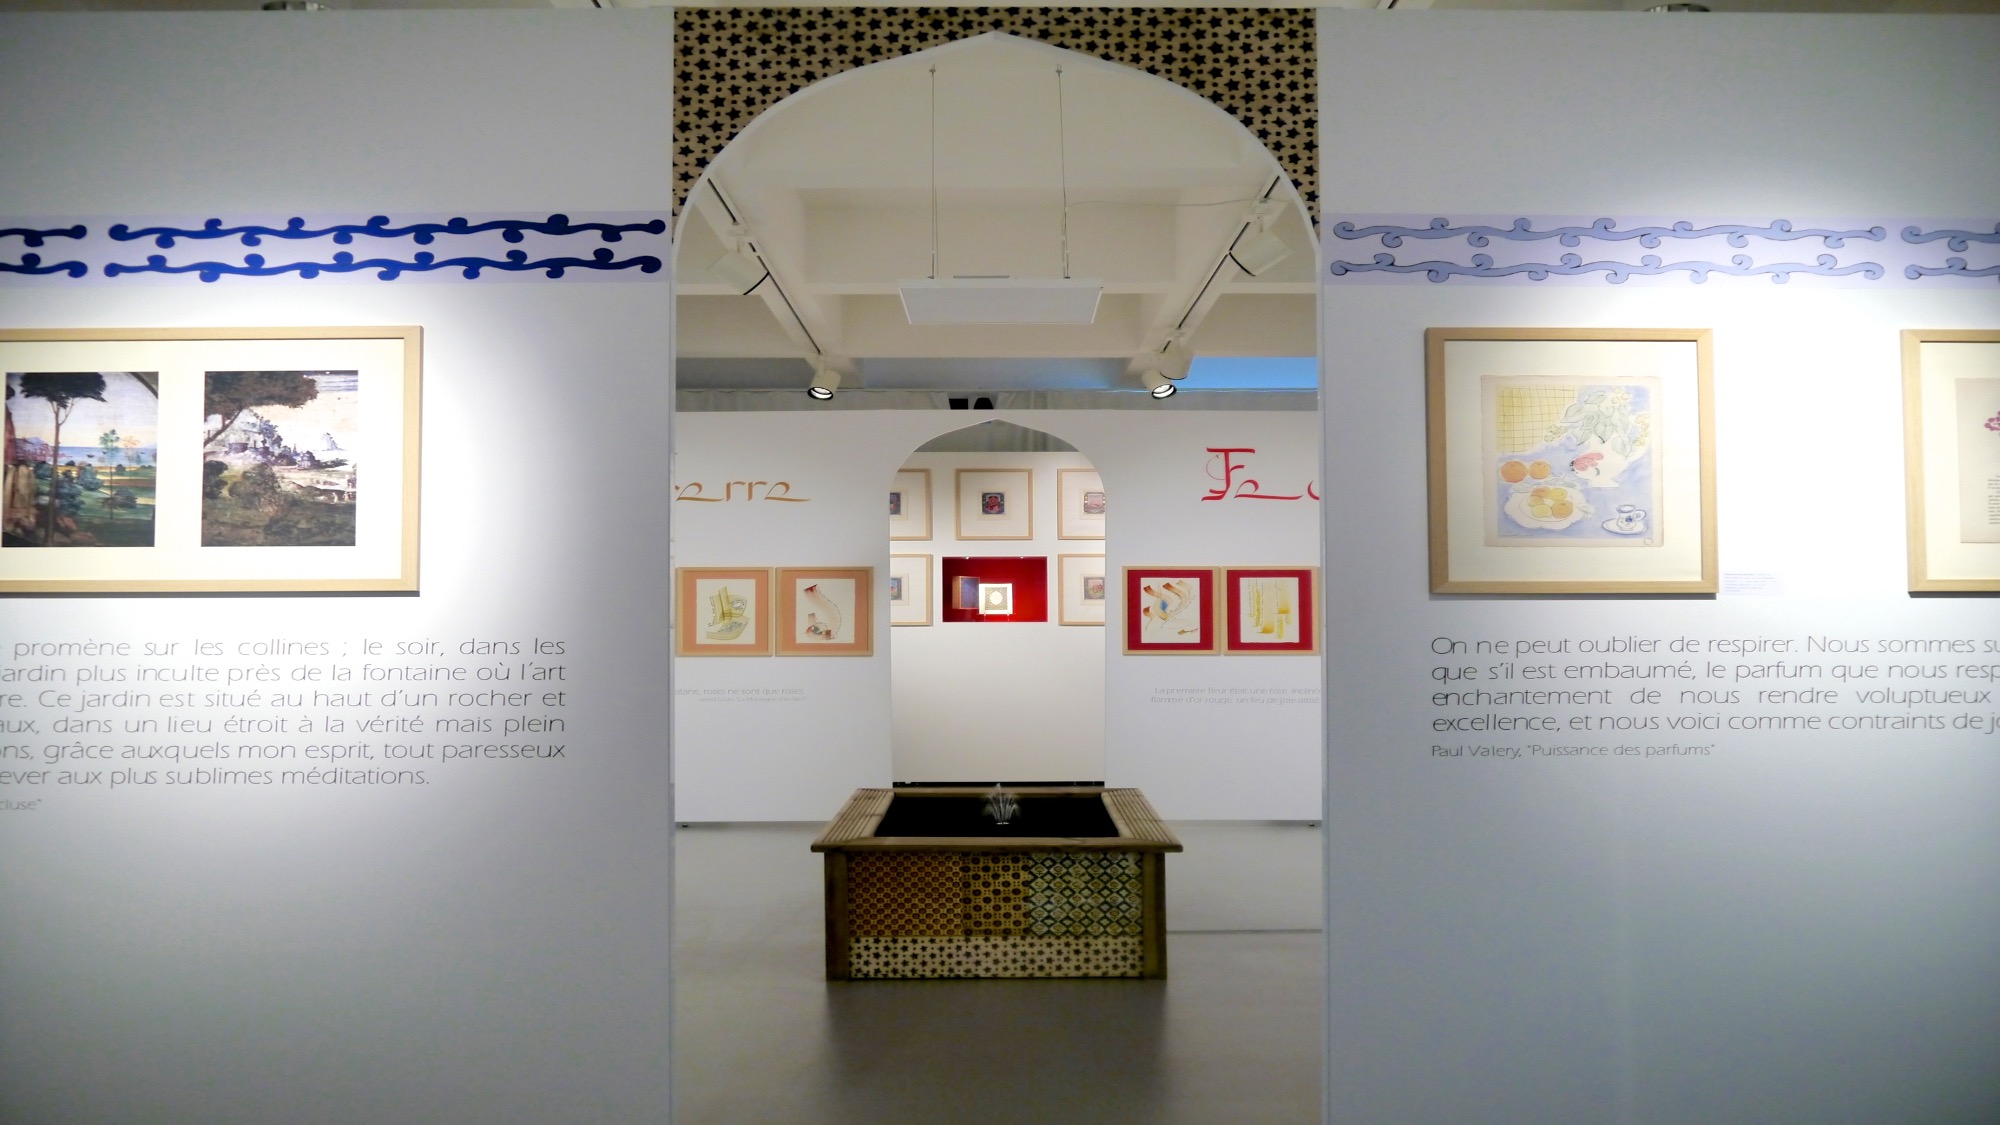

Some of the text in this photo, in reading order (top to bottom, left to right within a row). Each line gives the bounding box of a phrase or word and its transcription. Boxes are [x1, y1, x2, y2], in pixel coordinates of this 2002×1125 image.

[675, 480, 811, 502] erre
[14, 639, 131, 661] promène
[144, 642, 179, 656] sur
[195, 639, 223, 656] les
[238, 639, 329, 655] collines
[364, 638, 382, 655] le
[396, 638, 444, 657] soir,
[460, 638, 520, 655] dans
[535, 638, 565, 654] les
[1431, 637, 1467, 654] On
[1477, 641, 1509, 654] ne
[1516, 638, 1571, 658] peut
[1579, 636, 1662, 653] oublier
[1670, 636, 1700, 652] de
[1709, 636, 1798, 657] respirer.
[1808, 636, 1869, 653] Nous
[1878, 640, 1975, 653] sommes
[1, 662, 566, 686] ardin plus inculte près de la fontaine où l'art
[1432, 667, 1477, 684] que
[1489, 663, 1513, 679] s'il
[1522, 664, 1557, 679] est
[1564, 661, 1696, 680] embaumé,
[1707, 661, 1726, 678] le
[1736, 661, 1822, 683] parfum
[1832, 665, 1879, 683] que
[1888, 665, 1947, 678] nous
[38, 690, 71, 707] Ce
[75, 690, 150, 712] jardin
[159, 692, 195, 707] est
[204, 689, 261, 707] situé
[271, 694, 302, 707] au
[314, 690, 372, 707] haut
[381, 690, 437, 706] d'un
[449, 690, 533, 706] rocher
[542, 691, 566, 706] et
[762, 688, 780, 697] que
[1432, 687, 1992, 708] enchantement de nous rendre voluptueux
[53, 716, 112, 733] dans
[125, 720, 157, 733] un
[168, 716, 211, 733] lieu
[224, 715, 288, 733] étroit
[298, 715, 312, 733] à
[325, 716, 344, 732] la
[356, 715, 424, 732] vérité
[436, 716, 492, 732] mais
[504, 715, 564, 737] plein
[1433, 714, 1560, 732] excellence,
[1569, 715, 1594, 730] et
[1600, 717, 1659, 730] nous
[1666, 713, 1720, 729] voici
[1728, 716, 1821, 729] comme
[1828, 715, 1945, 729] contraints
[1952, 713, 1985, 730] de
[0, 741, 565, 764] ns, grâce auxquels mon esprit, tout paresseux
[1432, 745, 1463, 757] Paul
[1614, 745, 1640, 755] des
[58, 771, 102, 784] aux
[110, 768, 157, 789] plus
[166, 768, 272, 784] sublimes
[282, 767, 429, 784] méditations.
